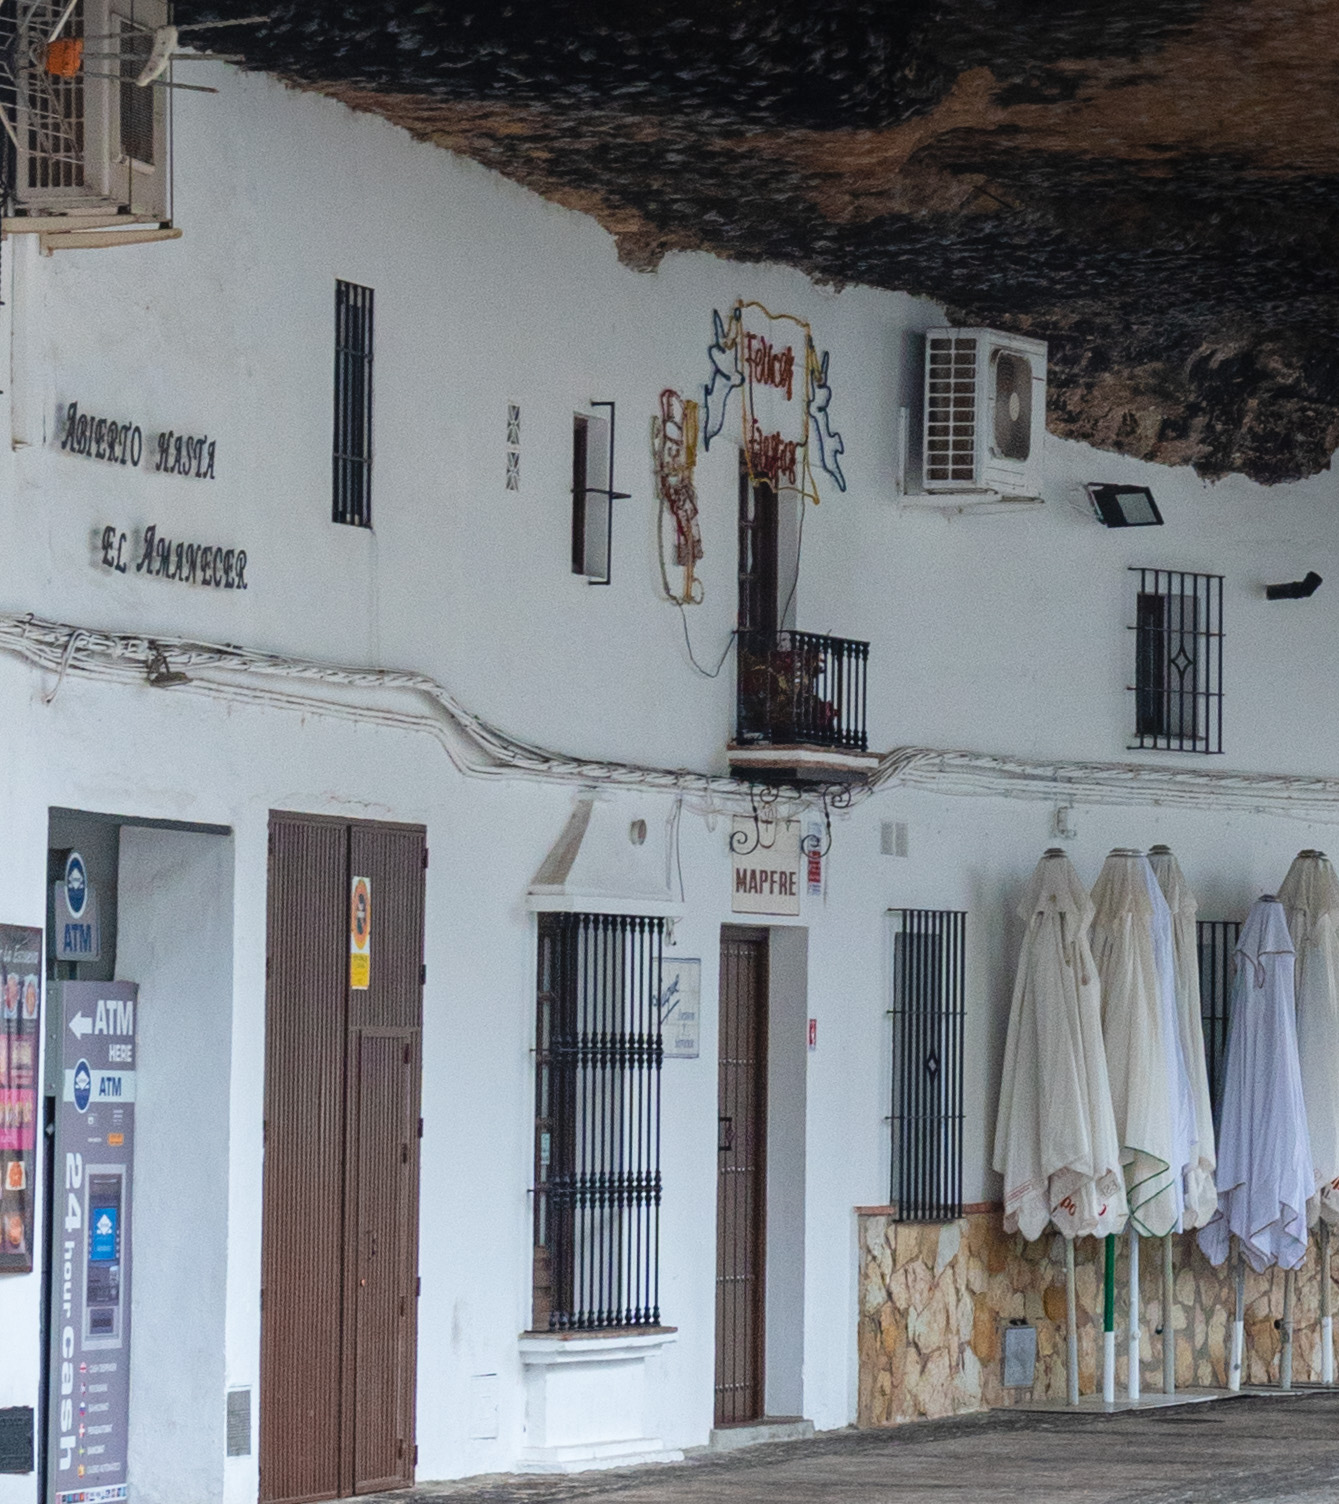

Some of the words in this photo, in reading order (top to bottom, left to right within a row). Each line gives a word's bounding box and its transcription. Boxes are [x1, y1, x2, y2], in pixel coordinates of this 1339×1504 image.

[735, 867, 797, 896] MAPFRE
[63, 923, 92, 953] ATM
[94, 999, 134, 1036] ATM
[108, 1043, 133, 1062] HERE
[98, 1076, 122, 1097] ATM
[64, 1152, 83, 1233] 24
[62, 1241, 75, 1319] hour
[58, 1325, 77, 1471] cash
